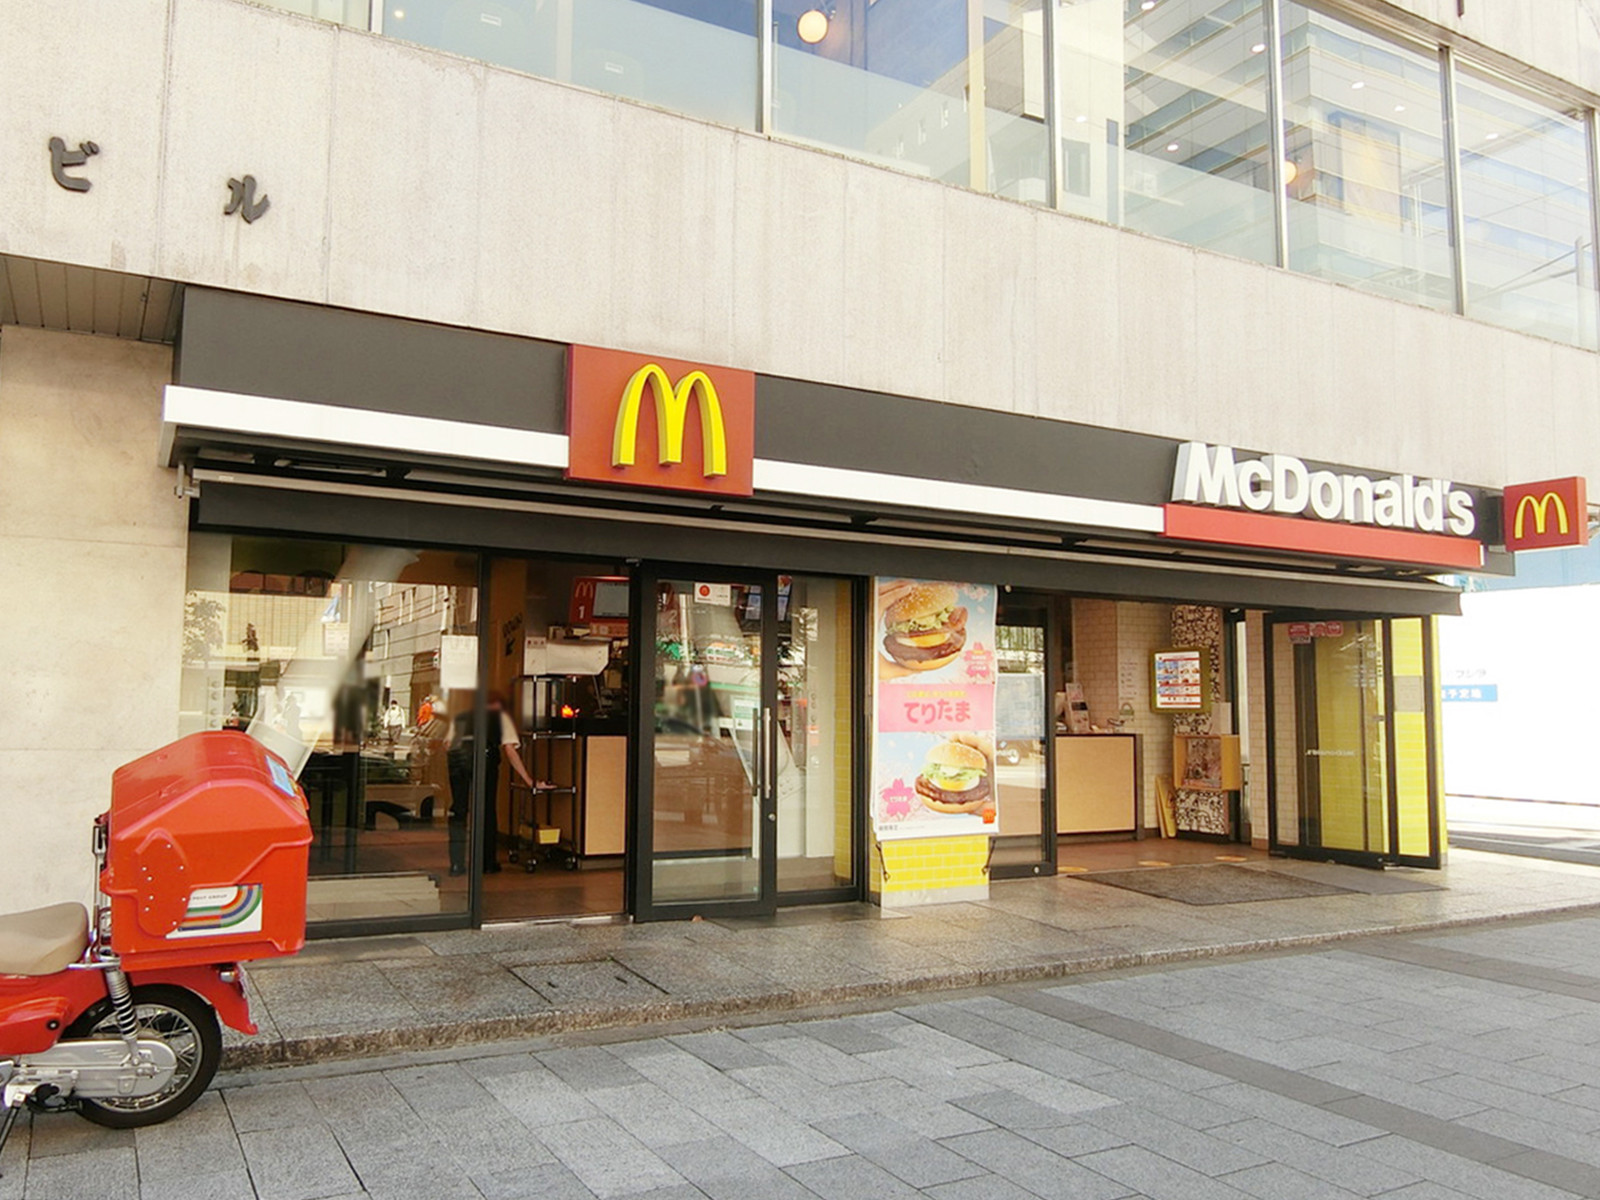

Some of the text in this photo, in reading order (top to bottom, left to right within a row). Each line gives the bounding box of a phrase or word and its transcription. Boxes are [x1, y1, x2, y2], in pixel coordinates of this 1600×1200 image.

[48, 136, 270, 225] ビル
[1171, 441, 1476, 537] McDonald's
[578, 605, 585, 619] 1
[903, 698, 971, 725] てりたま
